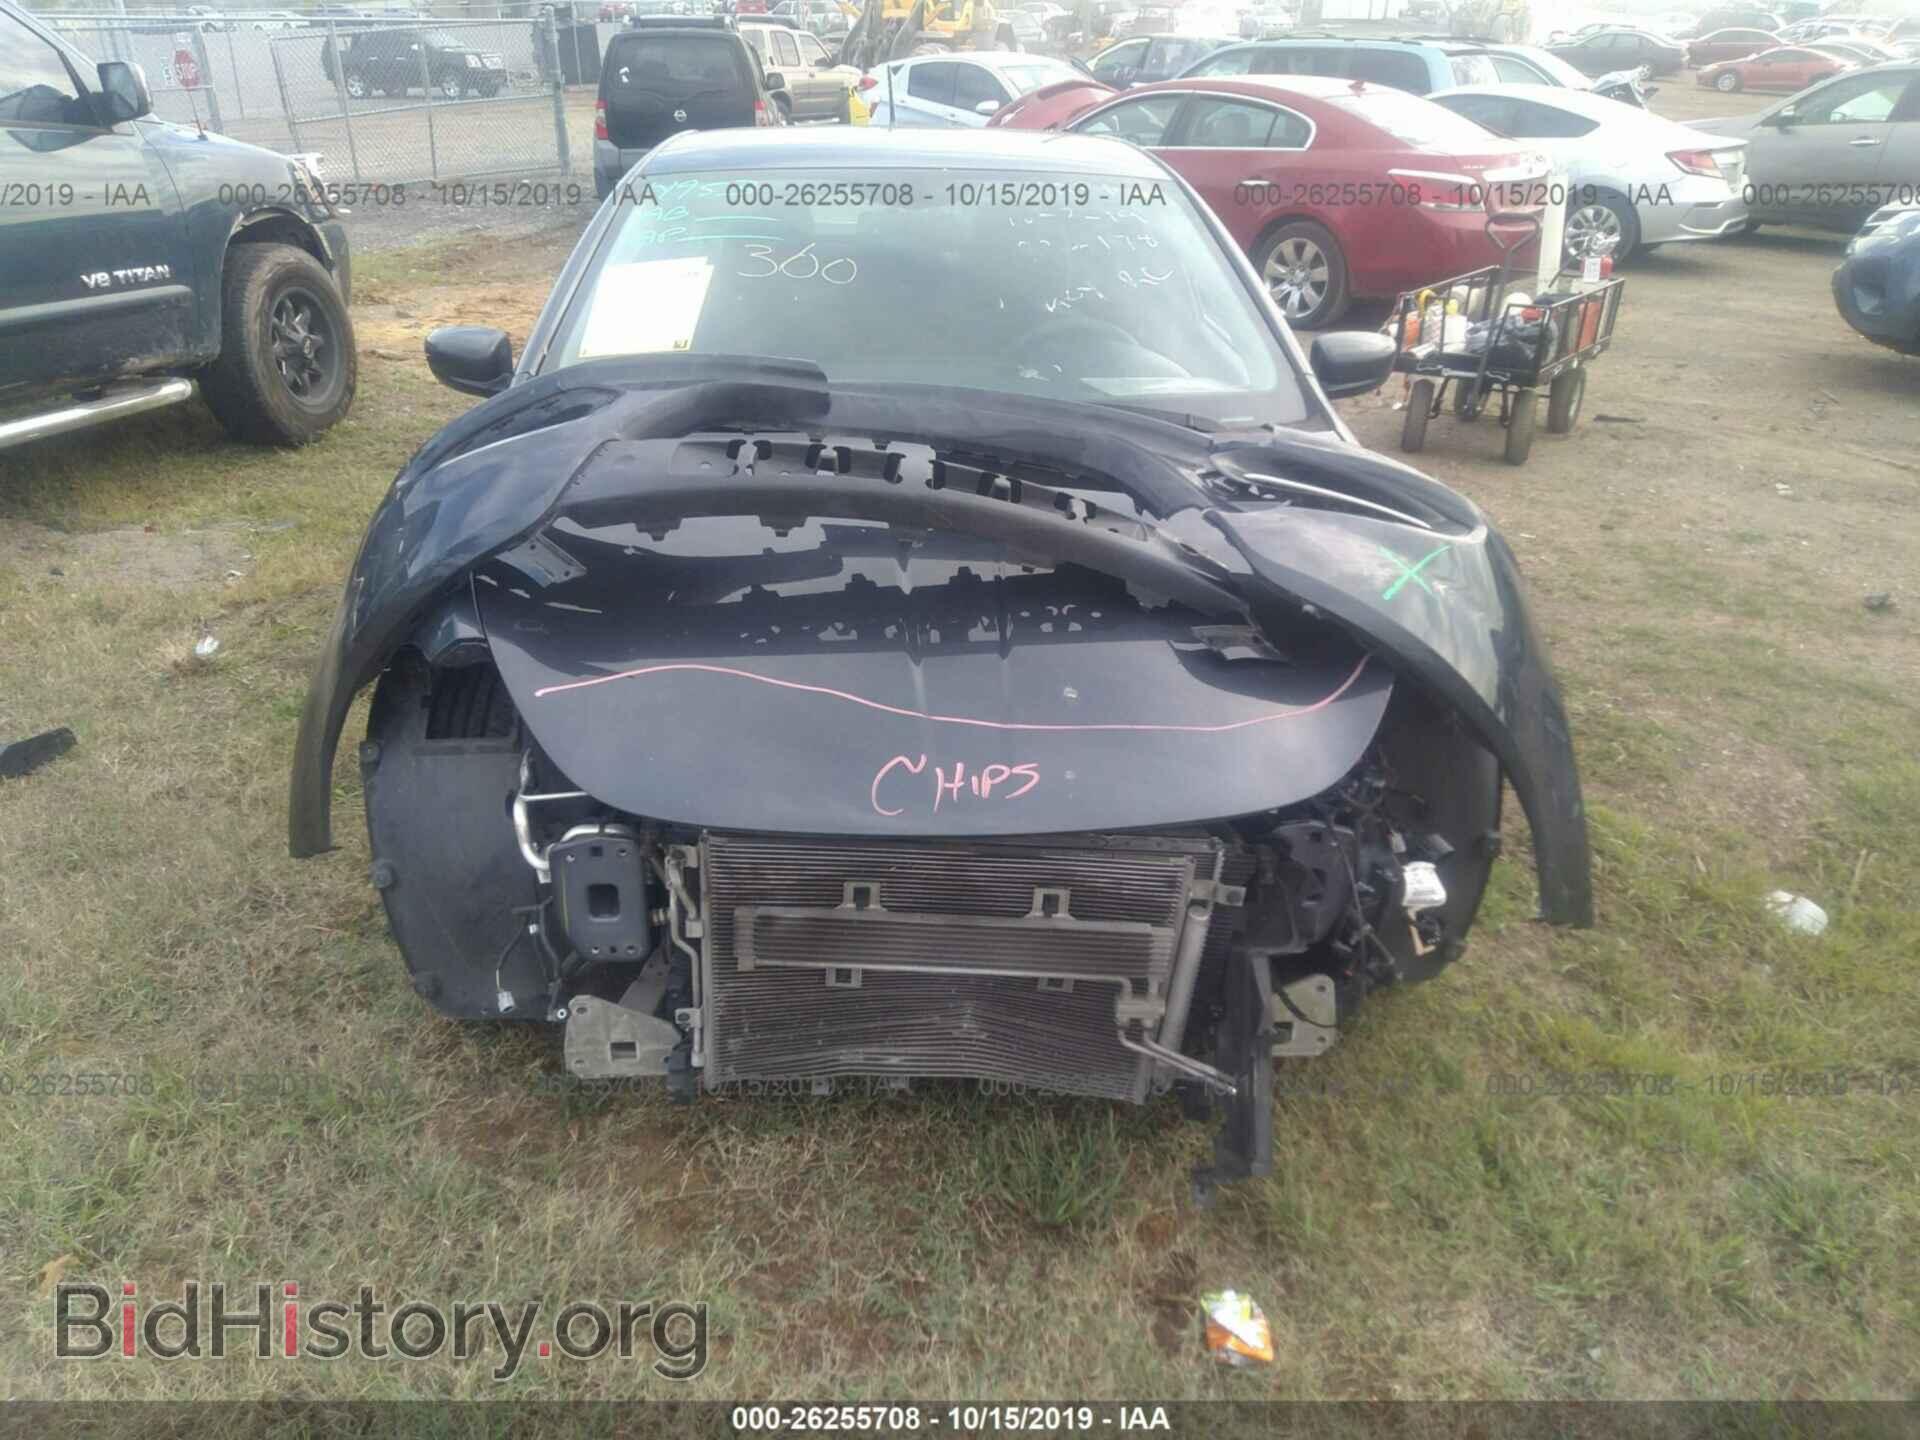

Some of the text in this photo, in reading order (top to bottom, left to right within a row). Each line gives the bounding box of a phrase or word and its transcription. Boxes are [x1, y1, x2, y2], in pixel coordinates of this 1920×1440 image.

[80, 264, 170, 289] V8 TITAN
[737, 242, 858, 285] 360
[871, 753, 1042, 817] CHIPS
